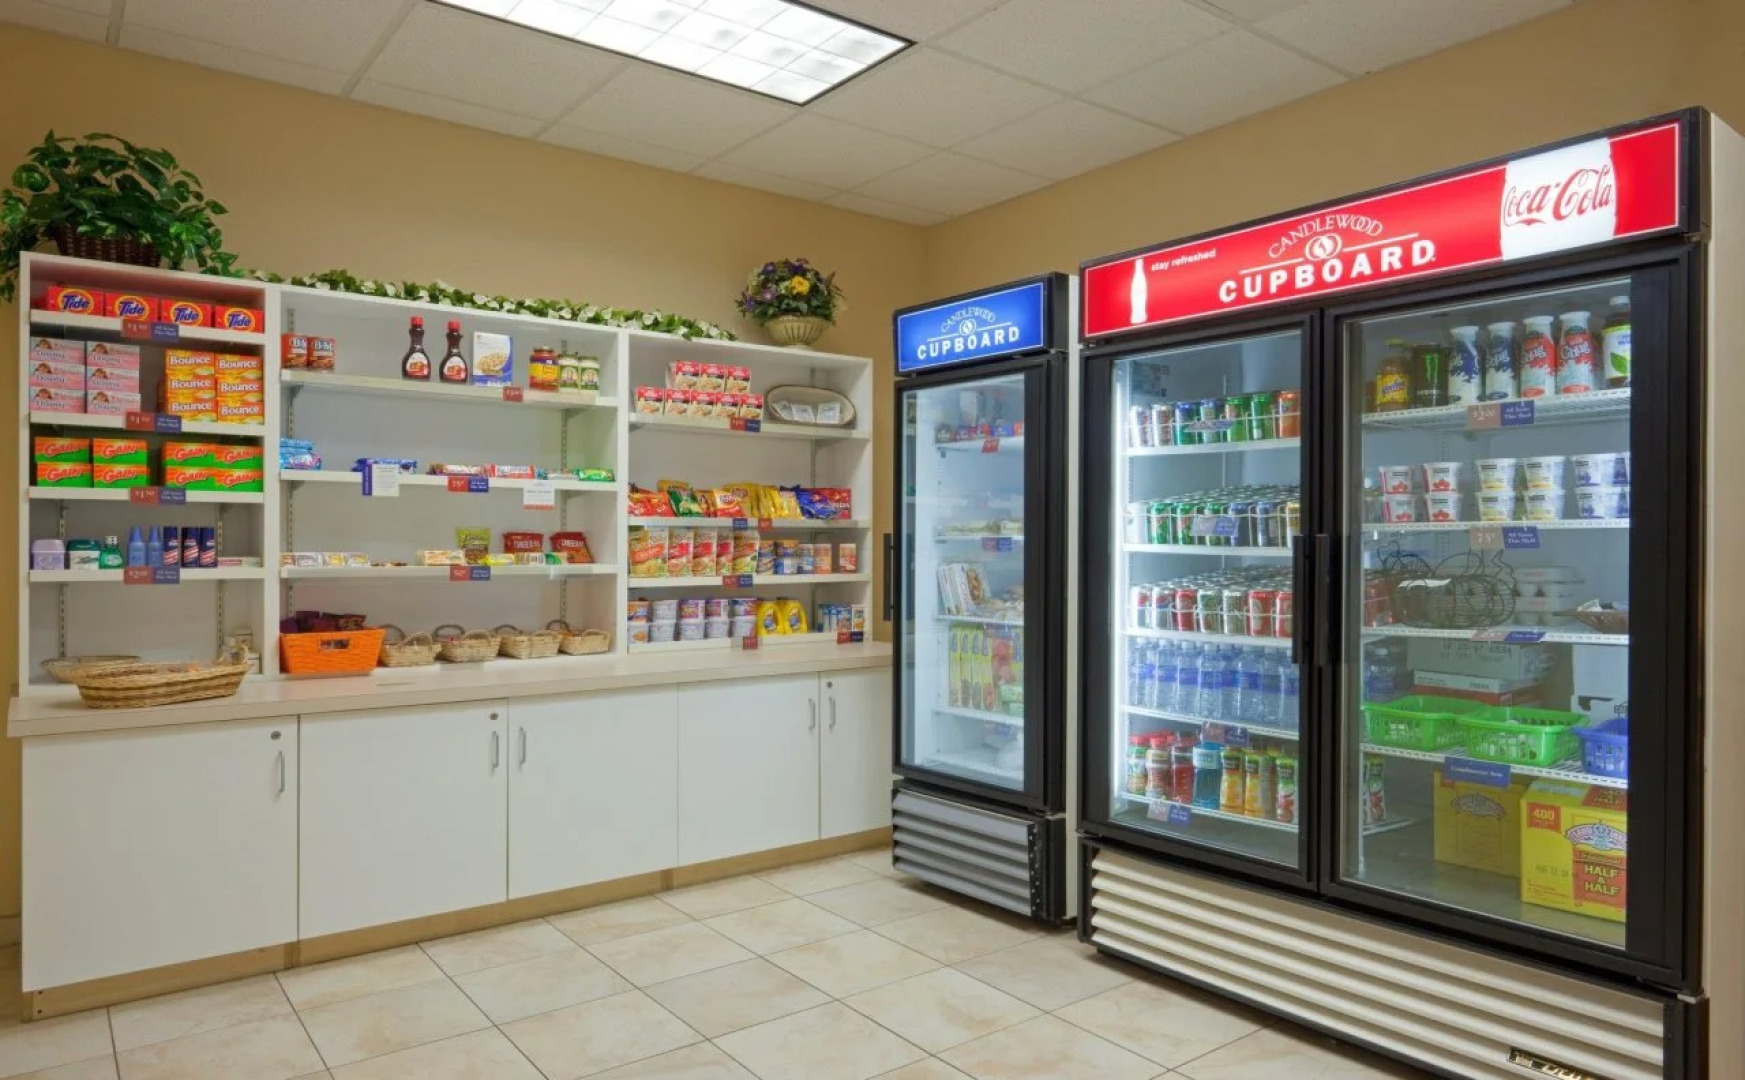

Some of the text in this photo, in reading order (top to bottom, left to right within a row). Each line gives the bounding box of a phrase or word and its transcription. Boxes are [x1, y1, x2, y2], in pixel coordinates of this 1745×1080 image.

[1503, 165, 1612, 226] Coca-Cola
[1268, 214, 1383, 258] CANDLEWOOD
[1151, 248, 1217, 272] stay refreshed
[1219, 239, 1436, 302] CUPBOARD
[63, 294, 89, 310] Tide
[119, 300, 145, 316] Tide
[174, 307, 199, 322] Tide
[228, 313, 252, 328] Tide
[941, 306, 996, 333] CANDLEWOOD
[917, 326, 1020, 360] CUPBOARD
[170, 355, 211, 365] Bounce
[219, 360, 258, 369] Bounce
[172, 379, 212, 389] Bounce
[221, 383, 259, 392] Bounce
[172, 401, 212, 411] Bounce
[221, 406, 260, 415] Bounce
[1533, 808, 1555, 821] 400
[1584, 864, 1619, 878] HALF
[1585, 882, 1620, 896] HALF
